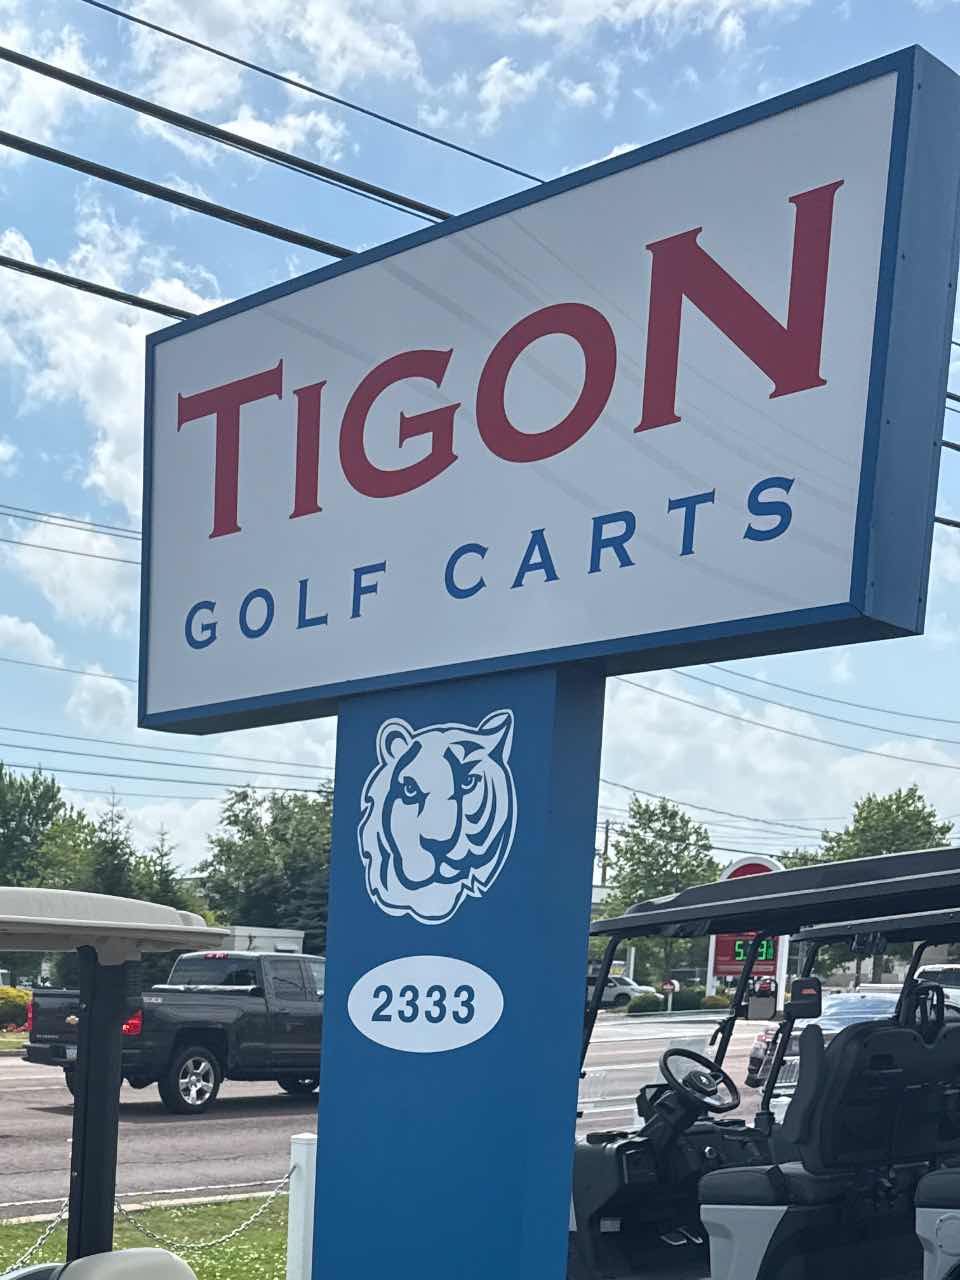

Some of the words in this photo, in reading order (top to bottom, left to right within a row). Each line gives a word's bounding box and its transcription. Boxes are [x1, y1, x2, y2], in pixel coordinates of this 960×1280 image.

[177, 178, 844, 539] TIGON
[184, 560, 387, 650] GOLF
[443, 476, 796, 601] CARTS
[371, 984, 476, 1025] 2333
